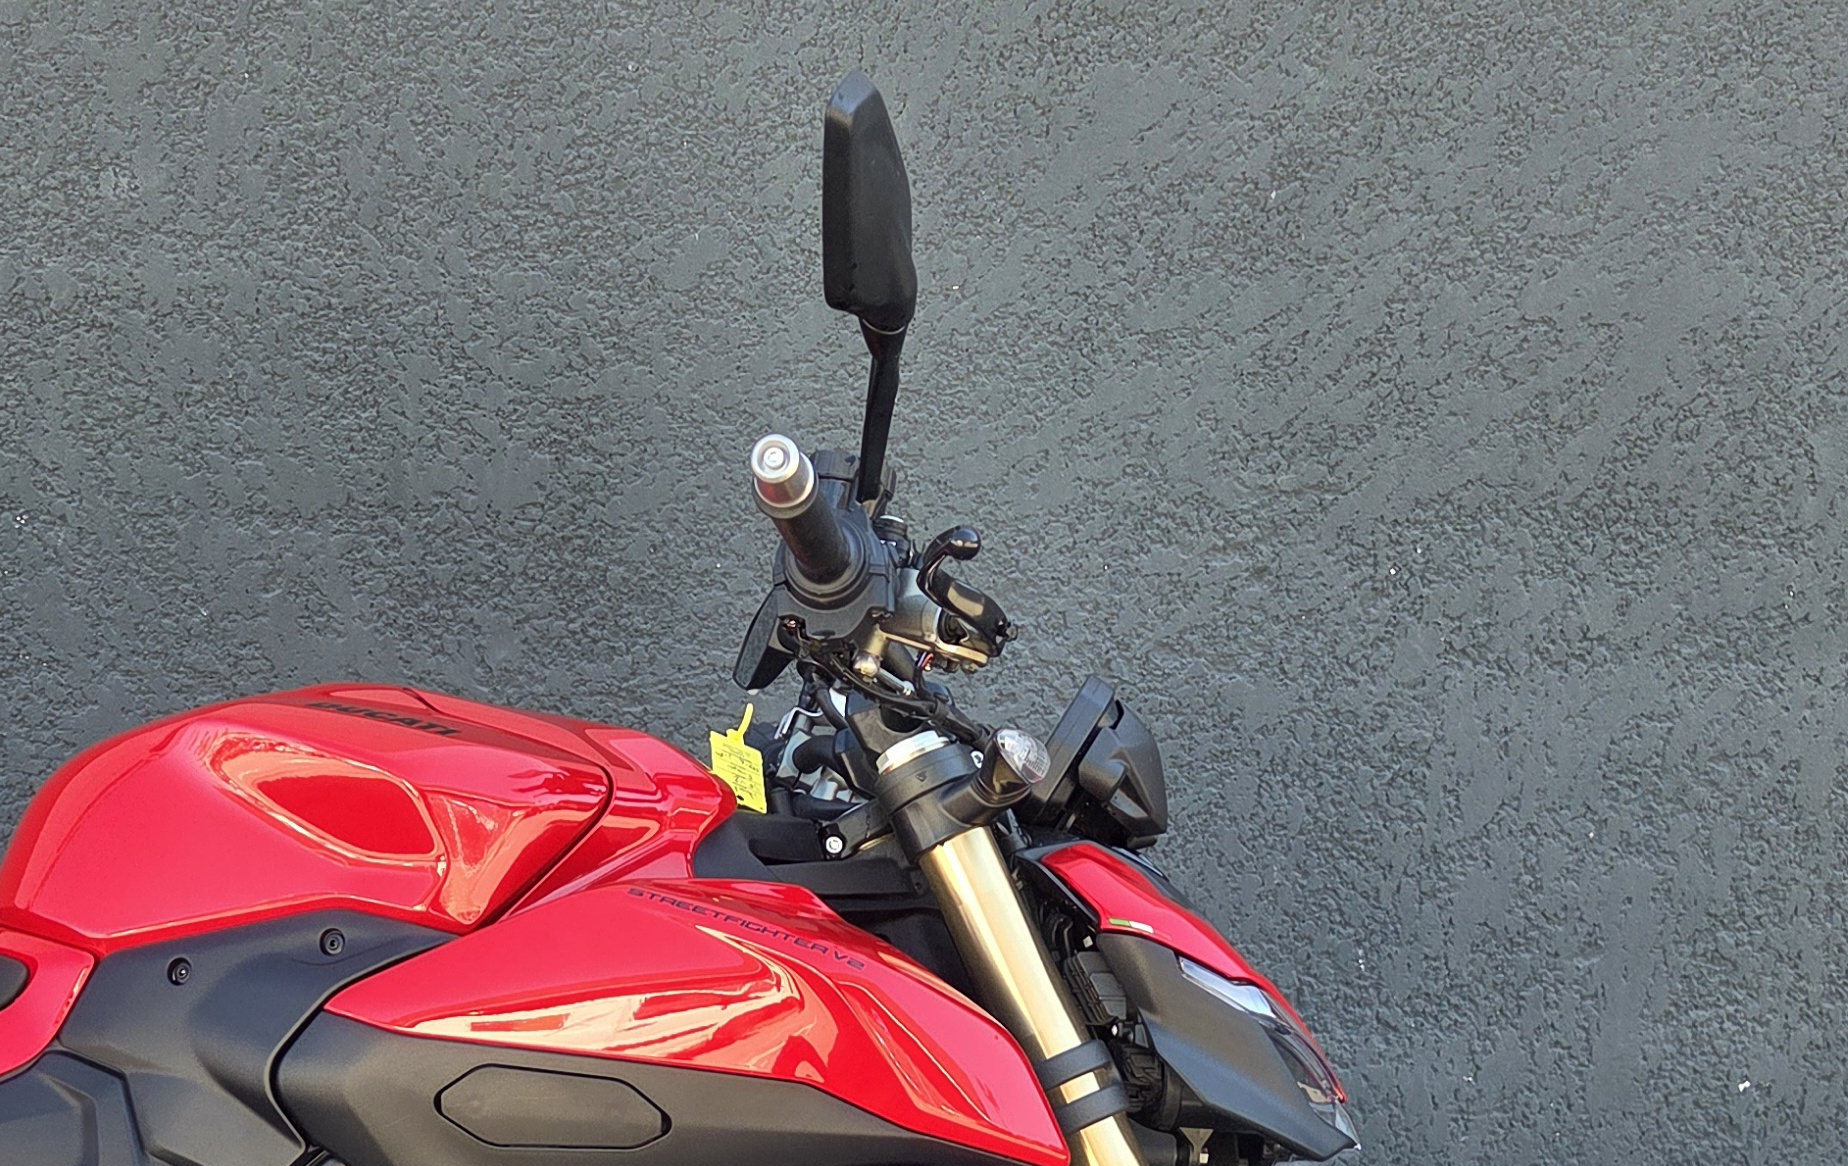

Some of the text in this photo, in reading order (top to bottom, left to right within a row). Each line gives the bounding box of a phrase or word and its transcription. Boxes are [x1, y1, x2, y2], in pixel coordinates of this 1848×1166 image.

[306, 702, 462, 737] DUCATI
[627, 887, 866, 971] STREETFIGHTER V2
